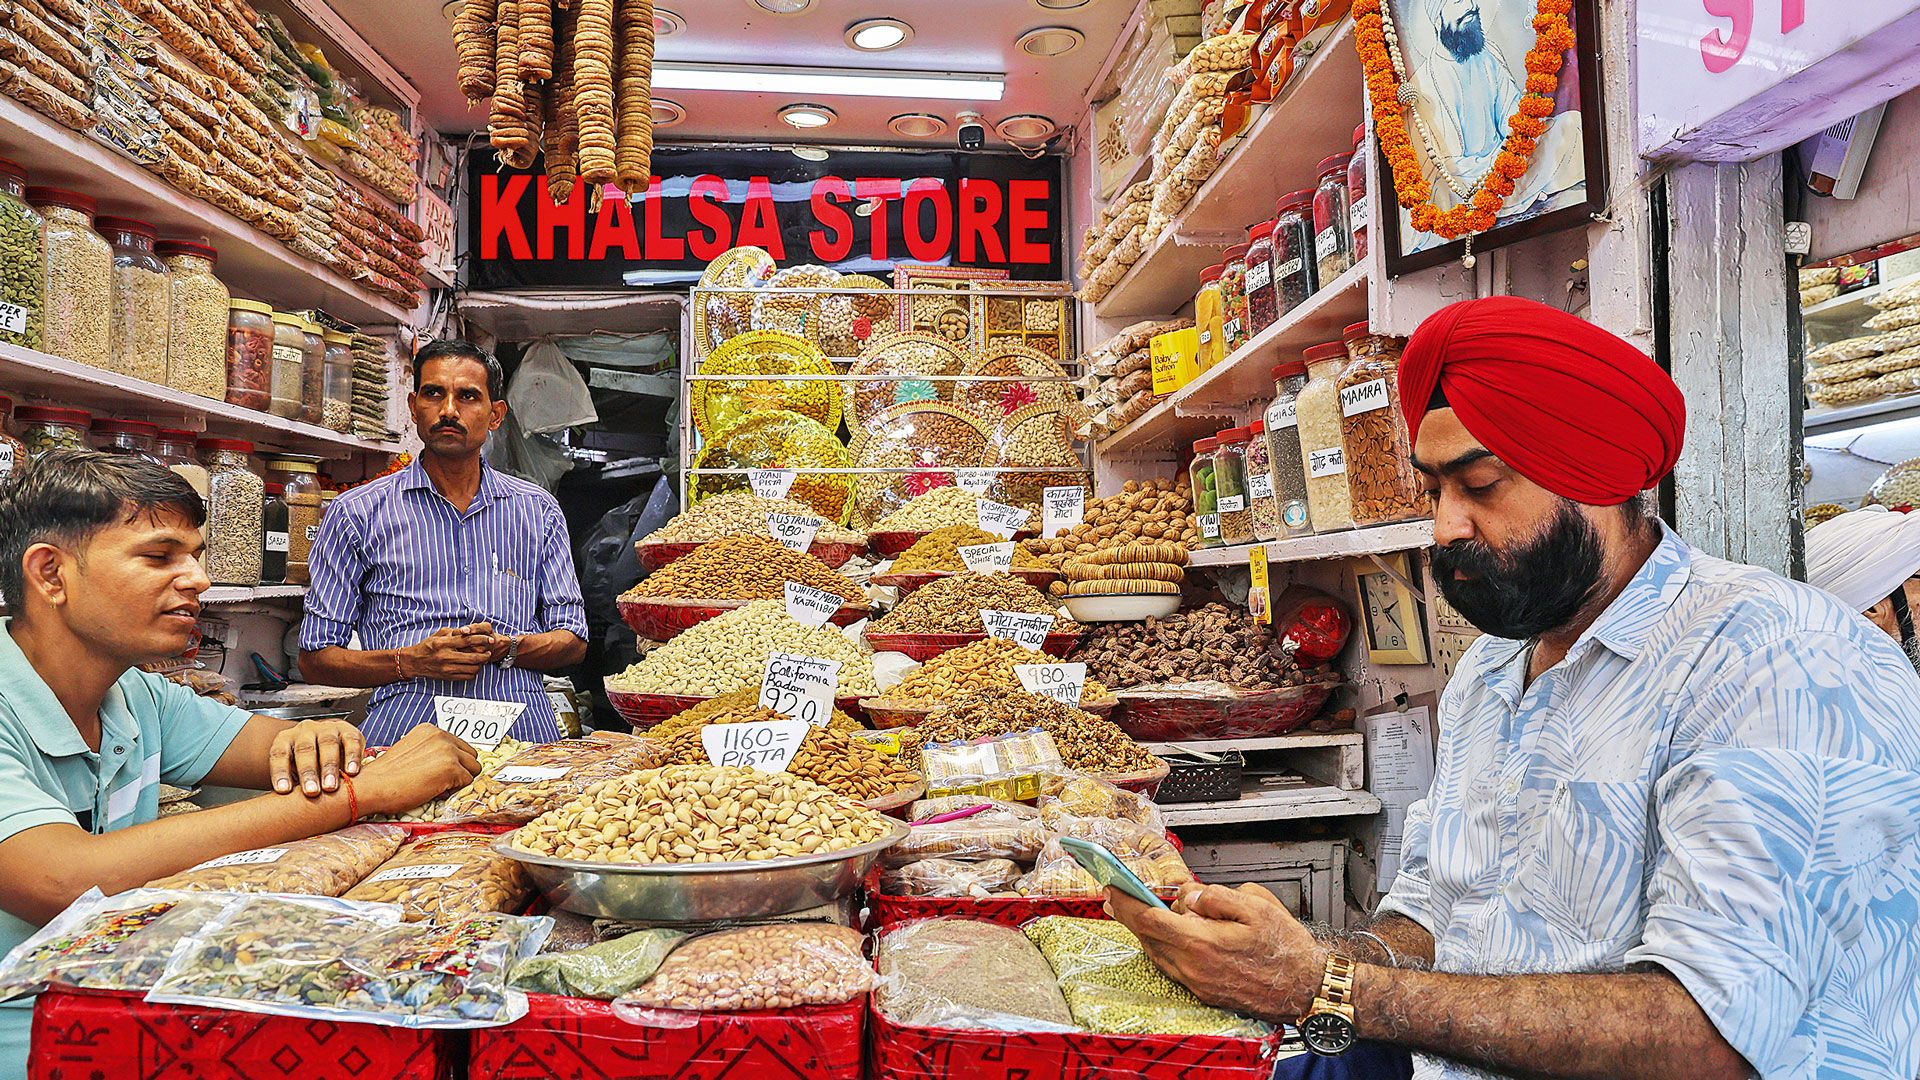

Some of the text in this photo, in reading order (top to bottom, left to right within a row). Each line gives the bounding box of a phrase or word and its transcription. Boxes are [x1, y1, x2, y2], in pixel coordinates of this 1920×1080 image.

[479, 173, 1051, 265] KHALSA STORE
[1224, 320, 1239, 336] MIX
[1154, 354, 1172, 365] Baby
[1155, 363, 1176, 374] Saffron
[1341, 382, 1383, 408] MAMRA
[751, 471, 782, 481] IRANI
[754, 488, 778, 499] 1360
[981, 500, 1019, 516] KISHMISH
[767, 513, 823, 528] AUSTRALIAN
[781, 538, 803, 549] NEW
[964, 545, 1002, 559] SPECIAL
[969, 555, 1012, 566] WHITE 1260
[788, 583, 842, 607] WHITE MOTA
[816, 602, 835, 614] 1180
[1020, 631, 1044, 645] 1260
[1391, 636, 1399, 646] 6
[769, 660, 830, 687] California
[441, 699, 477, 716] GOA
[720, 747, 786, 768] PISTA
